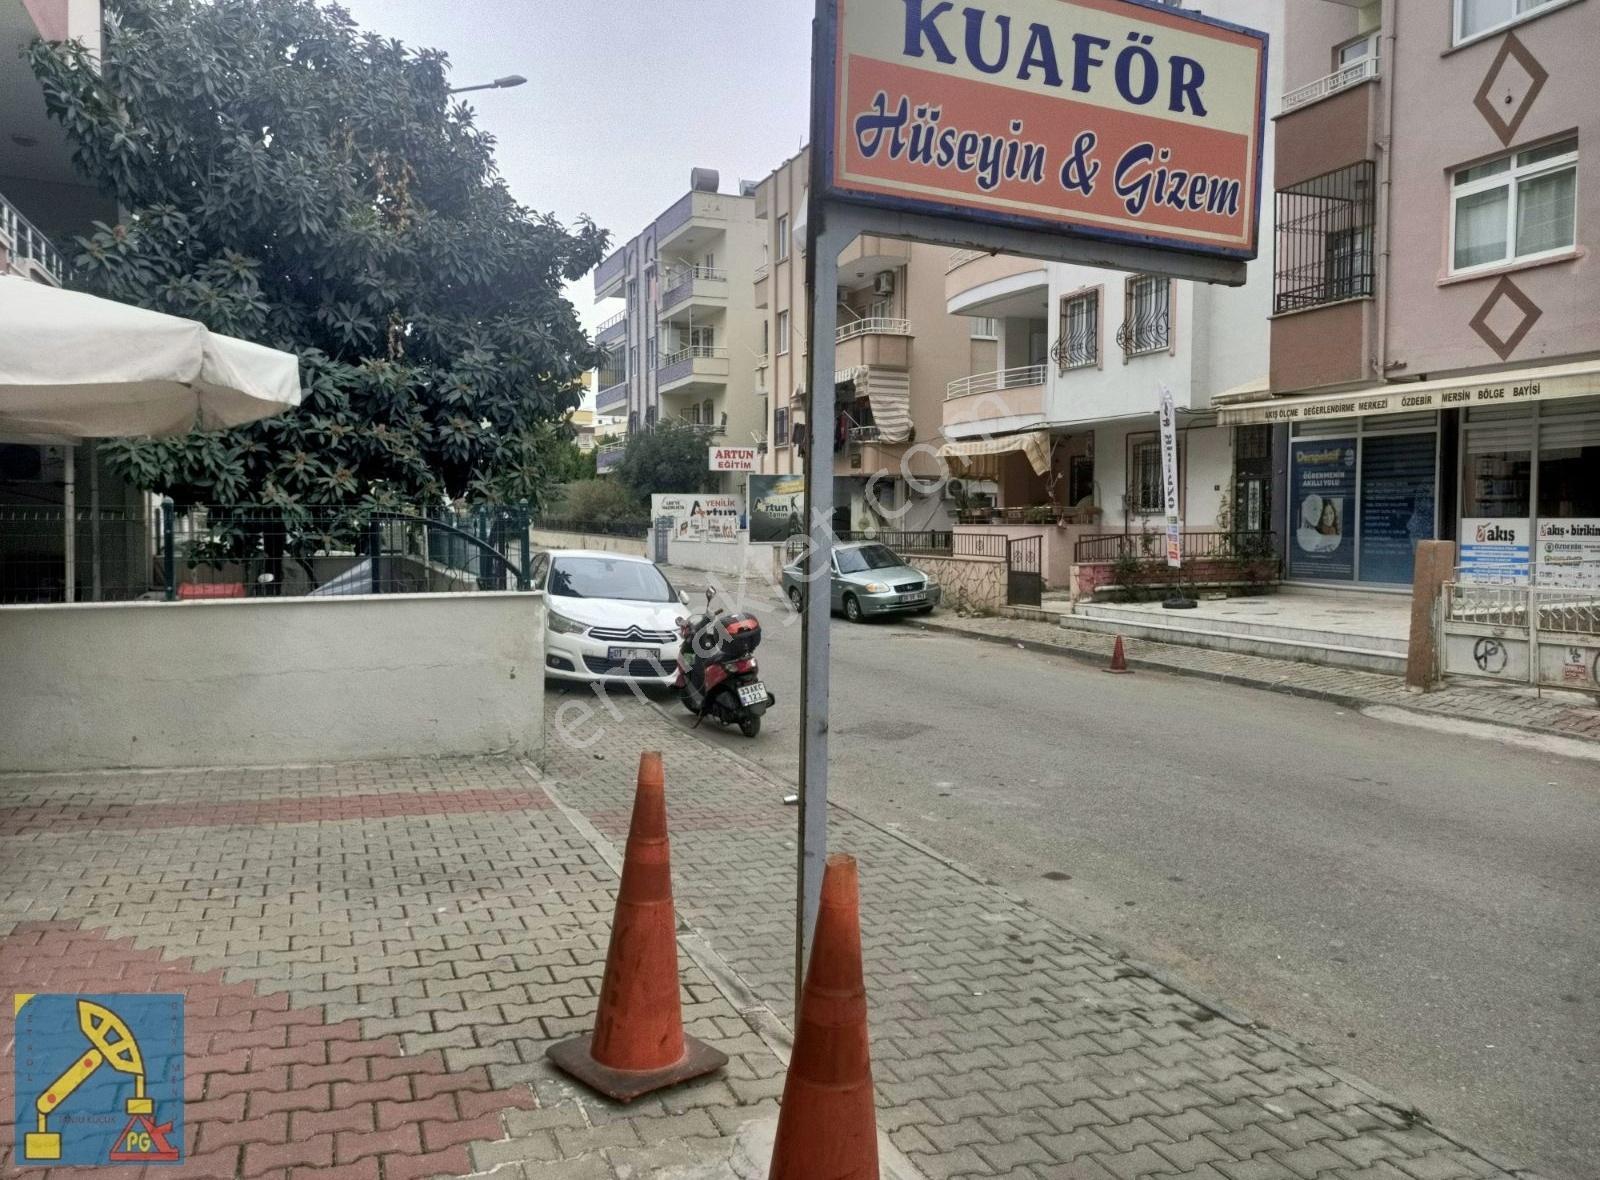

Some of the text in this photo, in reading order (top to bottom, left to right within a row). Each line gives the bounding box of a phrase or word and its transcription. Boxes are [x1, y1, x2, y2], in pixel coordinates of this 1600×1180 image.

[902, 0, 1208, 117] KUAFÖR
[855, 91, 1240, 216] Hüseyin & Gizem
[1303, 403, 1355, 416] DEĞERLENDİRME
[1358, 398, 1388, 410] MERKEZİ
[1401, 394, 1432, 407] ÖZDEBİR
[1441, 389, 1471, 403] MERSİN
[1478, 388, 1505, 400] BÖLGE
[715, 449, 754, 459] ARTUN
[718, 460, 752, 469] EĞİTİM
[705, 497, 736, 507] YENİLİK
